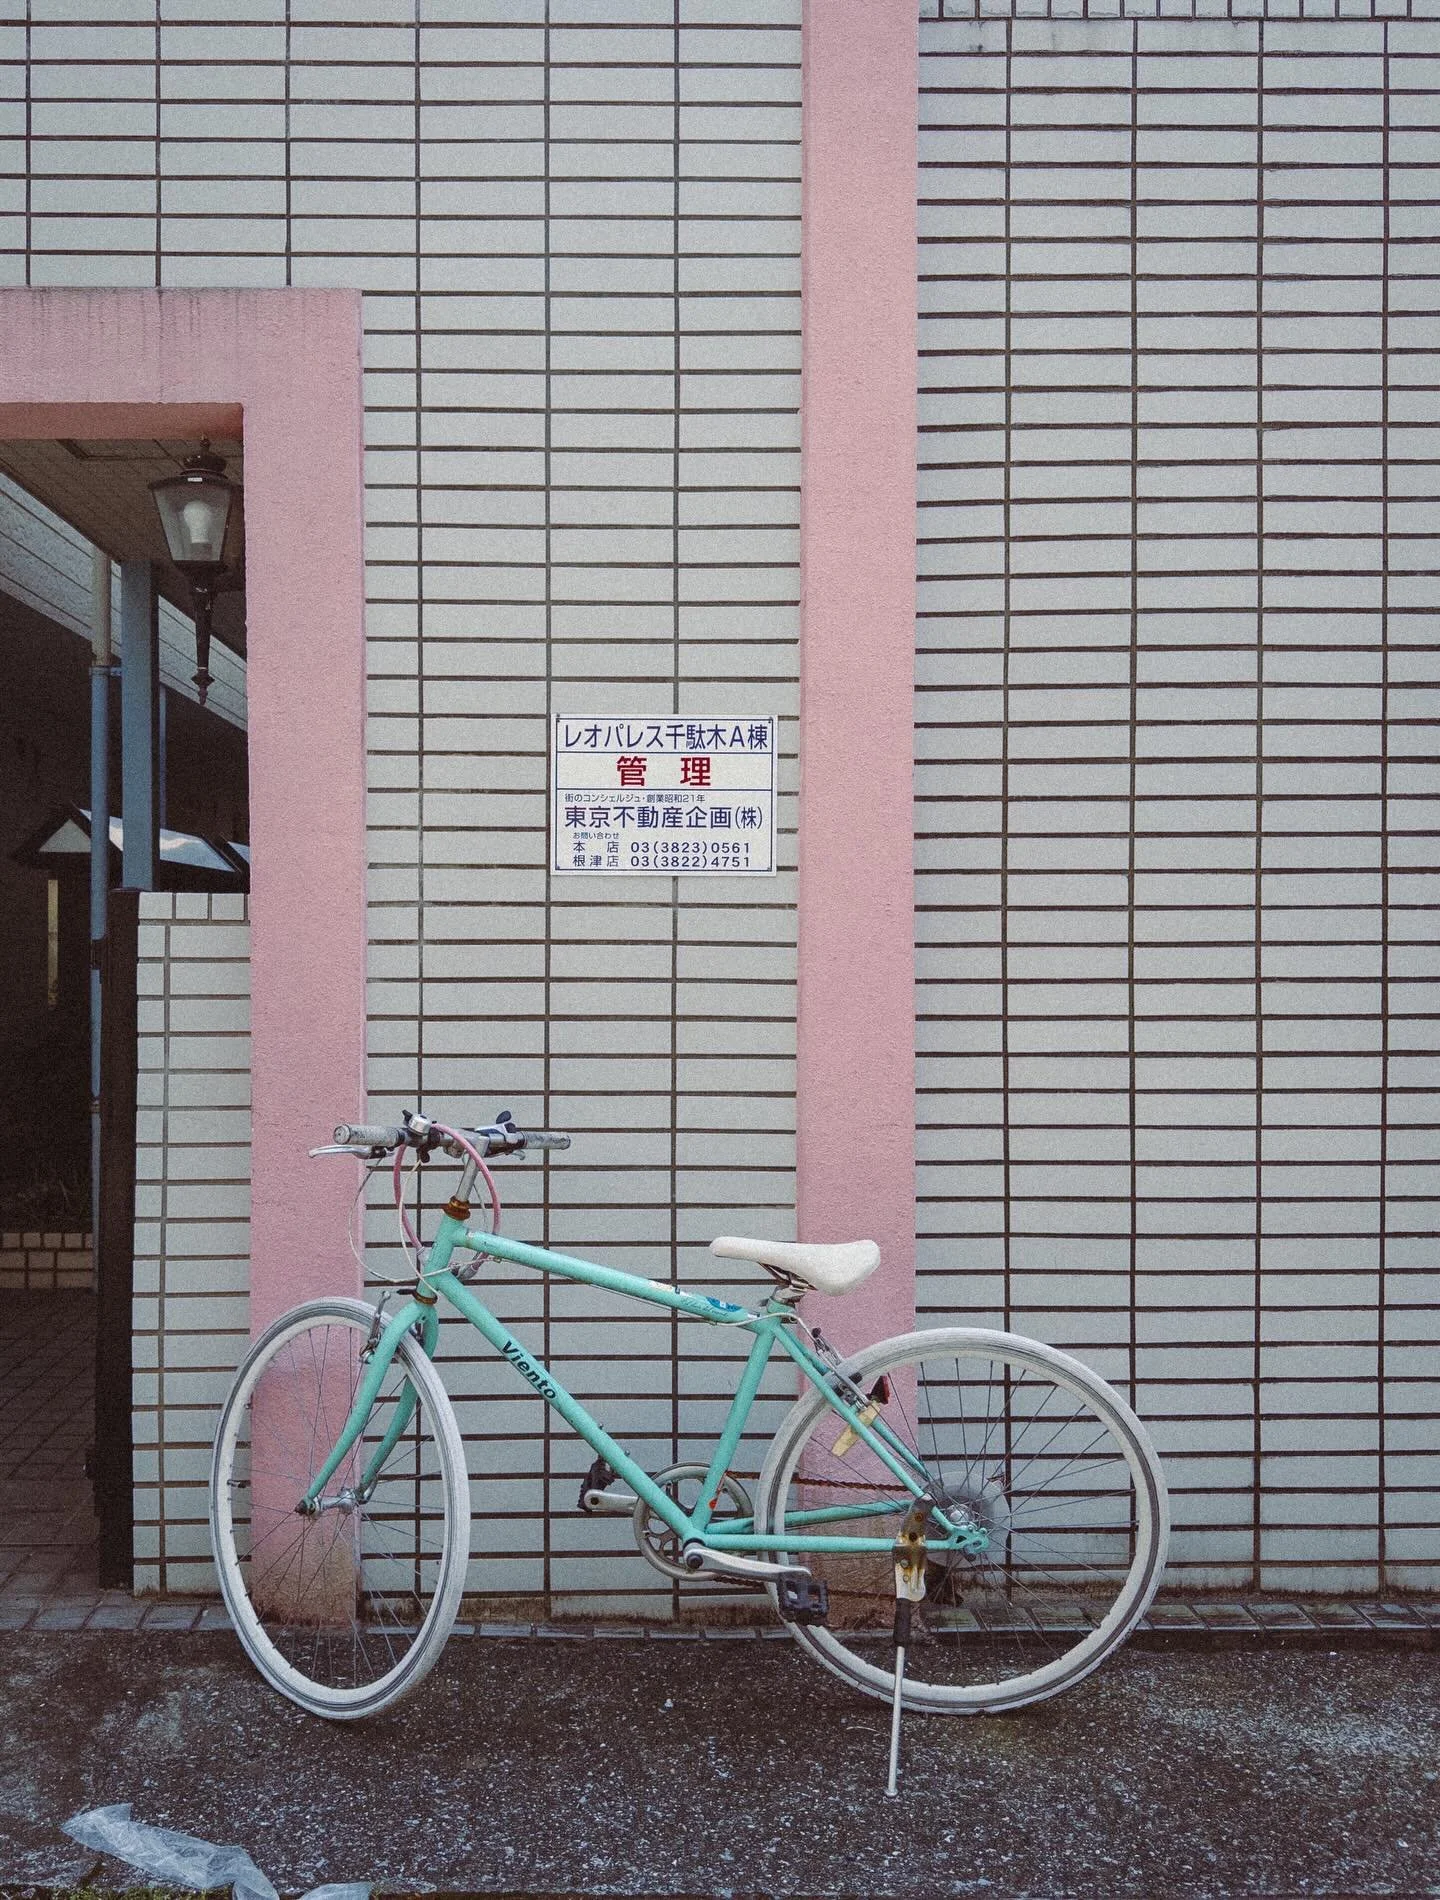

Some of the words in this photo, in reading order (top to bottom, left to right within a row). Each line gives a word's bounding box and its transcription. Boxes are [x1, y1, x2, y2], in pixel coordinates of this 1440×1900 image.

[564, 723, 769, 750] レオパレス千駄木A棟
[564, 805, 763, 829] 東京不動産企画(株)
[573, 831, 620, 840] お問い合わせ
[630, 841, 751, 854] 03(3823)0561
[572, 855, 620, 867] 根津店
[630, 855, 751, 868] 03(3822)4751
[502, 1340, 556, 1399] Viento
